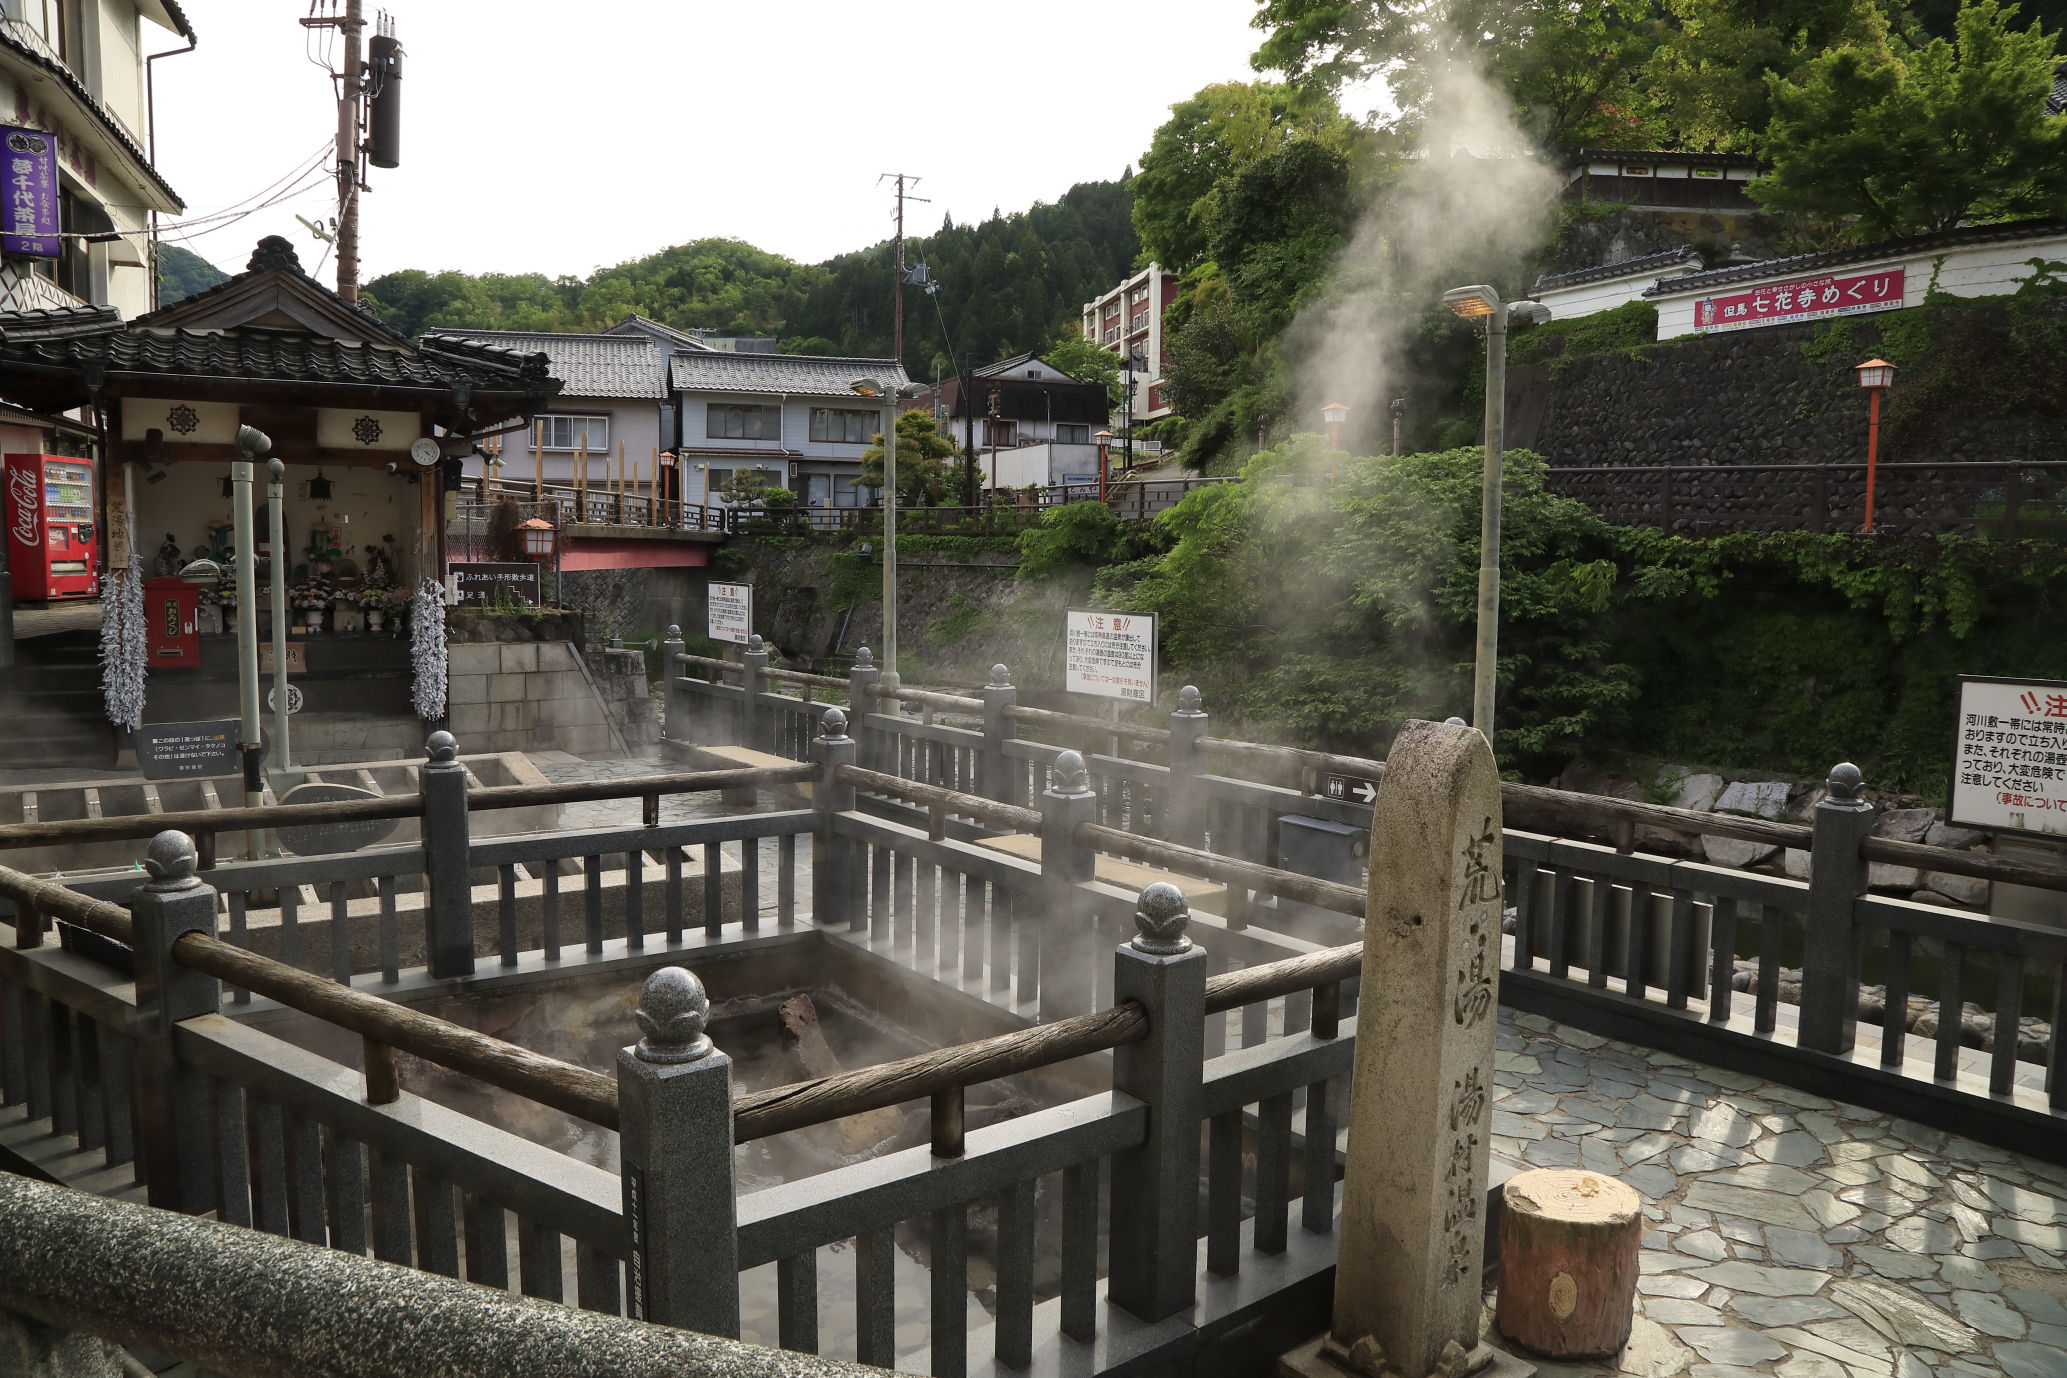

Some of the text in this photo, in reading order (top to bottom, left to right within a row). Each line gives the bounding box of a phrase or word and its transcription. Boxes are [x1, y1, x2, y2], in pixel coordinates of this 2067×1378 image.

[11, 157, 36, 238] 夢千代茶屋
[1724, 302, 1748, 318] 但馬
[1752, 277, 1890, 314] 七花寺めぐり
[465, 573, 535, 582] ふれあい手形散歩道
[167, 607, 178, 636] おみくじ
[1966, 713, 2067, 735] 河川敷一帯には常時
[1960, 773, 2044, 793] 注意してください
[1455, 816, 1500, 1030] 荒湯
